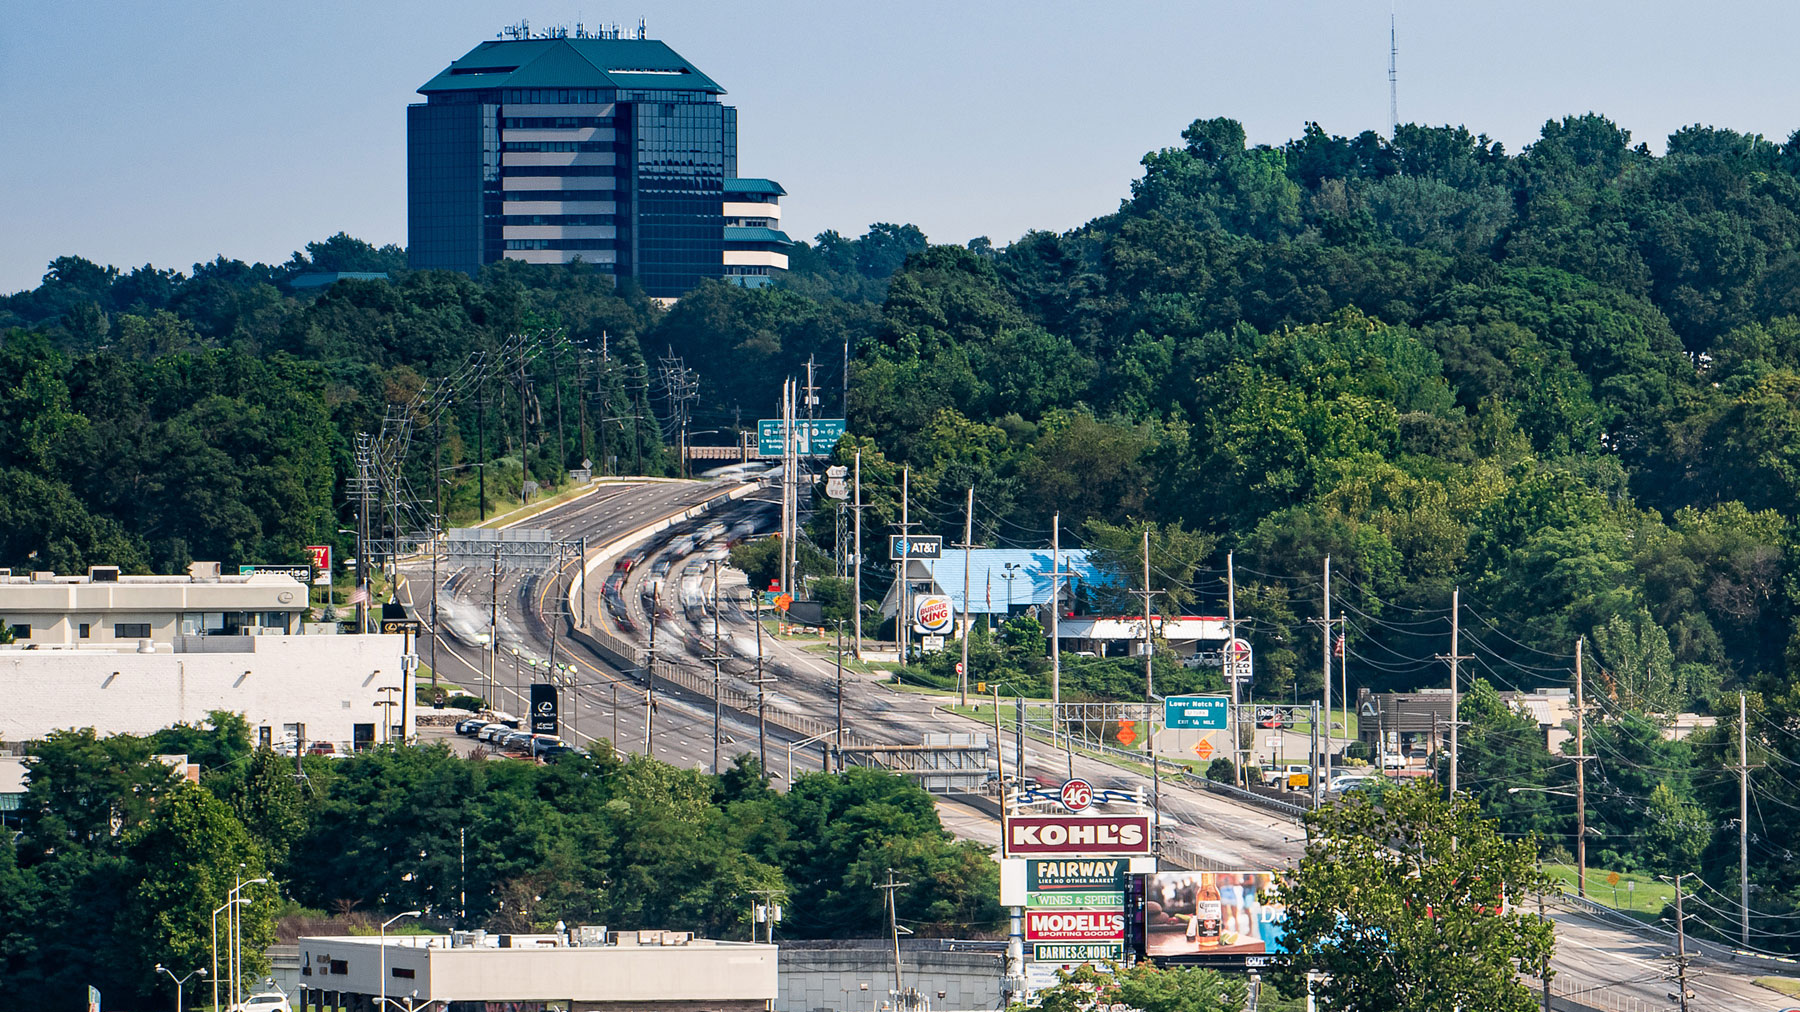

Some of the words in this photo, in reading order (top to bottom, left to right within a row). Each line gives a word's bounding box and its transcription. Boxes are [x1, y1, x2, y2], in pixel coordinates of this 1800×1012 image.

[911, 542, 938, 553] AT&T
[920, 602, 947, 616] BURGER
[921, 609, 948, 625] KING
[1064, 787, 1091, 806] 46
[1013, 823, 1144, 846] KOHL'S
[1037, 860, 1118, 878] FAIRWAY
[1039, 895, 1073, 905] WINES
[1075, 895, 1083, 905] &
[1084, 894, 1123, 905] SPIRITS
[1031, 914, 1125, 932] MODELL'S
